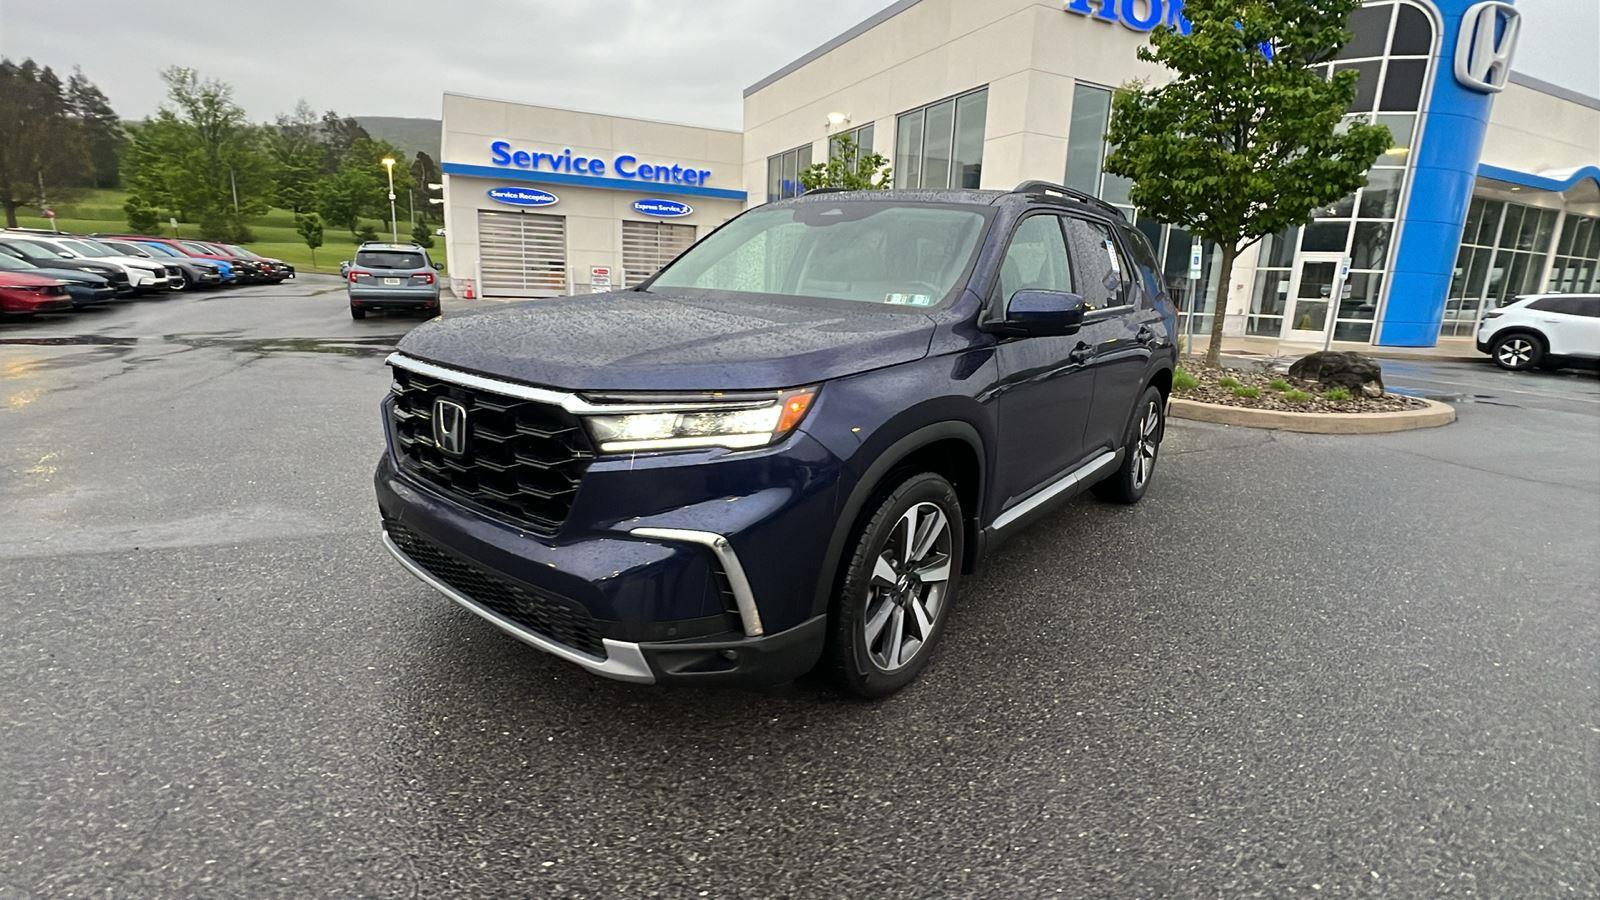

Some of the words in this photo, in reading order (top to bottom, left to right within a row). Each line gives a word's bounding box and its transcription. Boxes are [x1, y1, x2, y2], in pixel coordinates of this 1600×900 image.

[491, 141, 605, 175] Service
[614, 155, 711, 186] Center
[491, 190, 518, 199] Service
[518, 192, 554, 202] Reception
[634, 202, 658, 211] Express
[658, 204, 681, 212] Service
